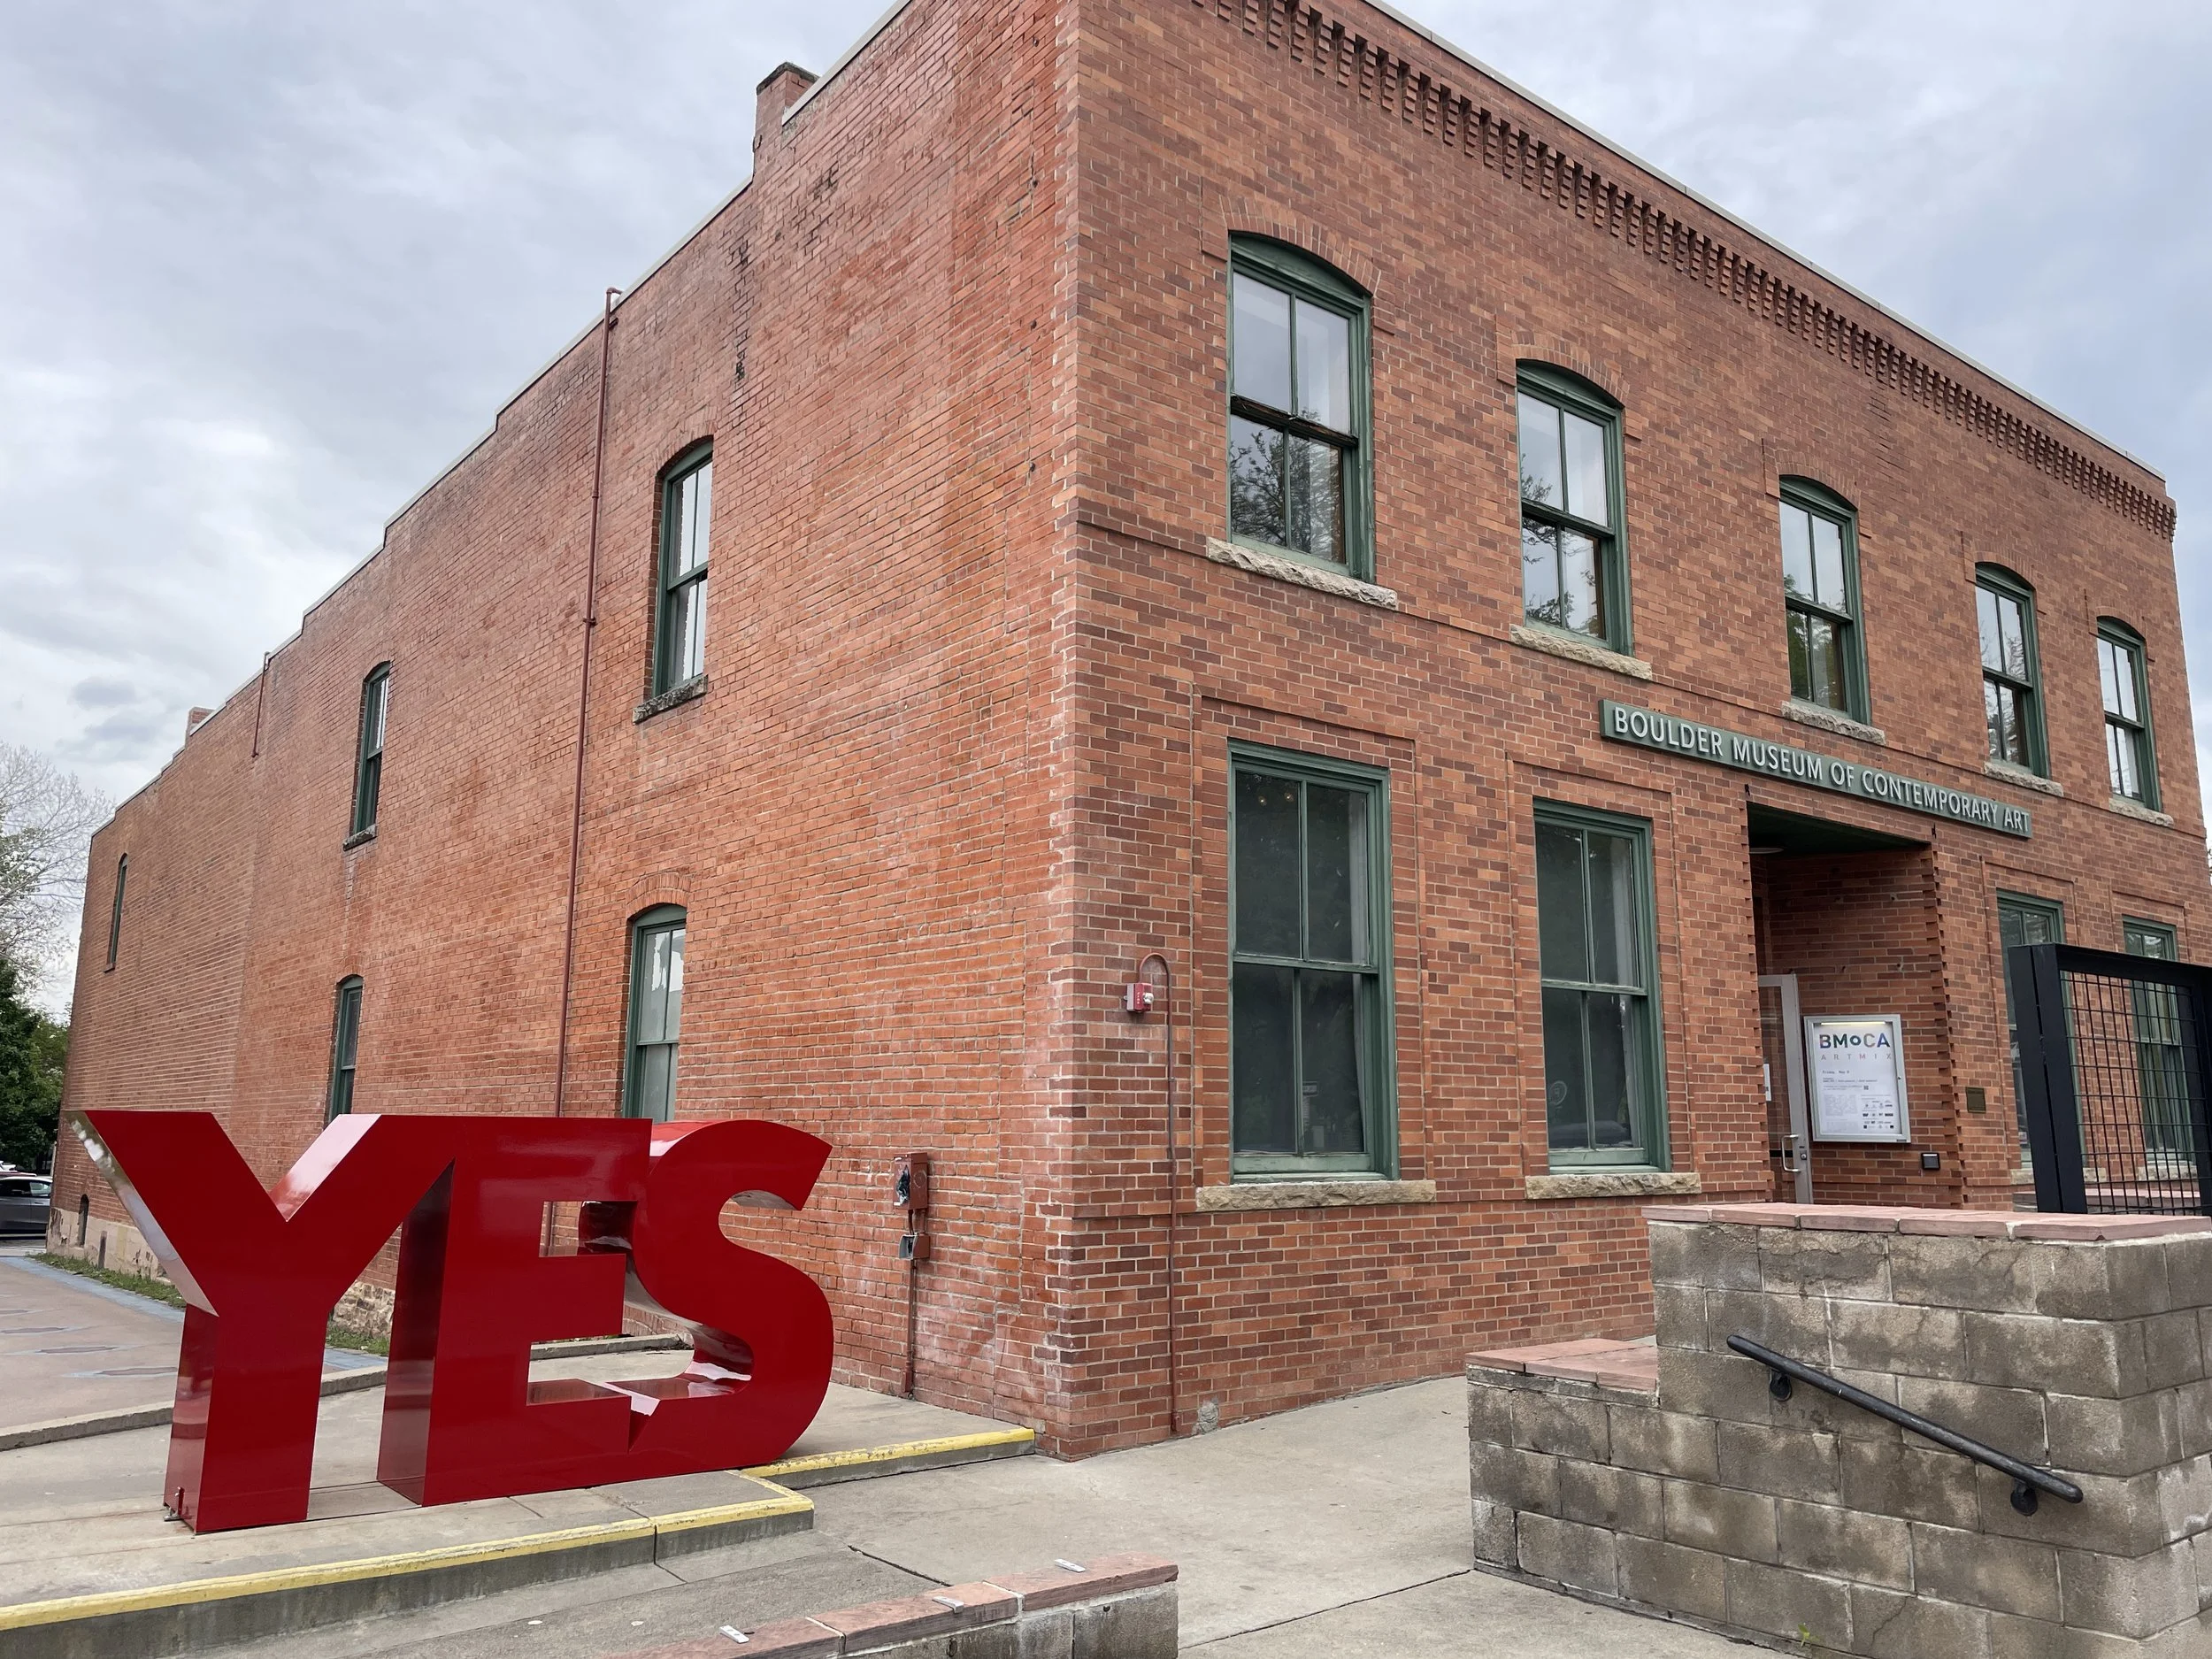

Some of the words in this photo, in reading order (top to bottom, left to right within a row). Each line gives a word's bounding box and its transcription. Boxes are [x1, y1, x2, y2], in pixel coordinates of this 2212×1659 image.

[1614, 706, 1724, 757] BOULDER
[1732, 736, 1823, 780] MUSEUM
[1831, 762, 1855, 787] OF
[1862, 770, 1998, 822] CONTEMPORARY
[2003, 807, 2030, 833] ART
[67, 1110, 834, 1534] YES
